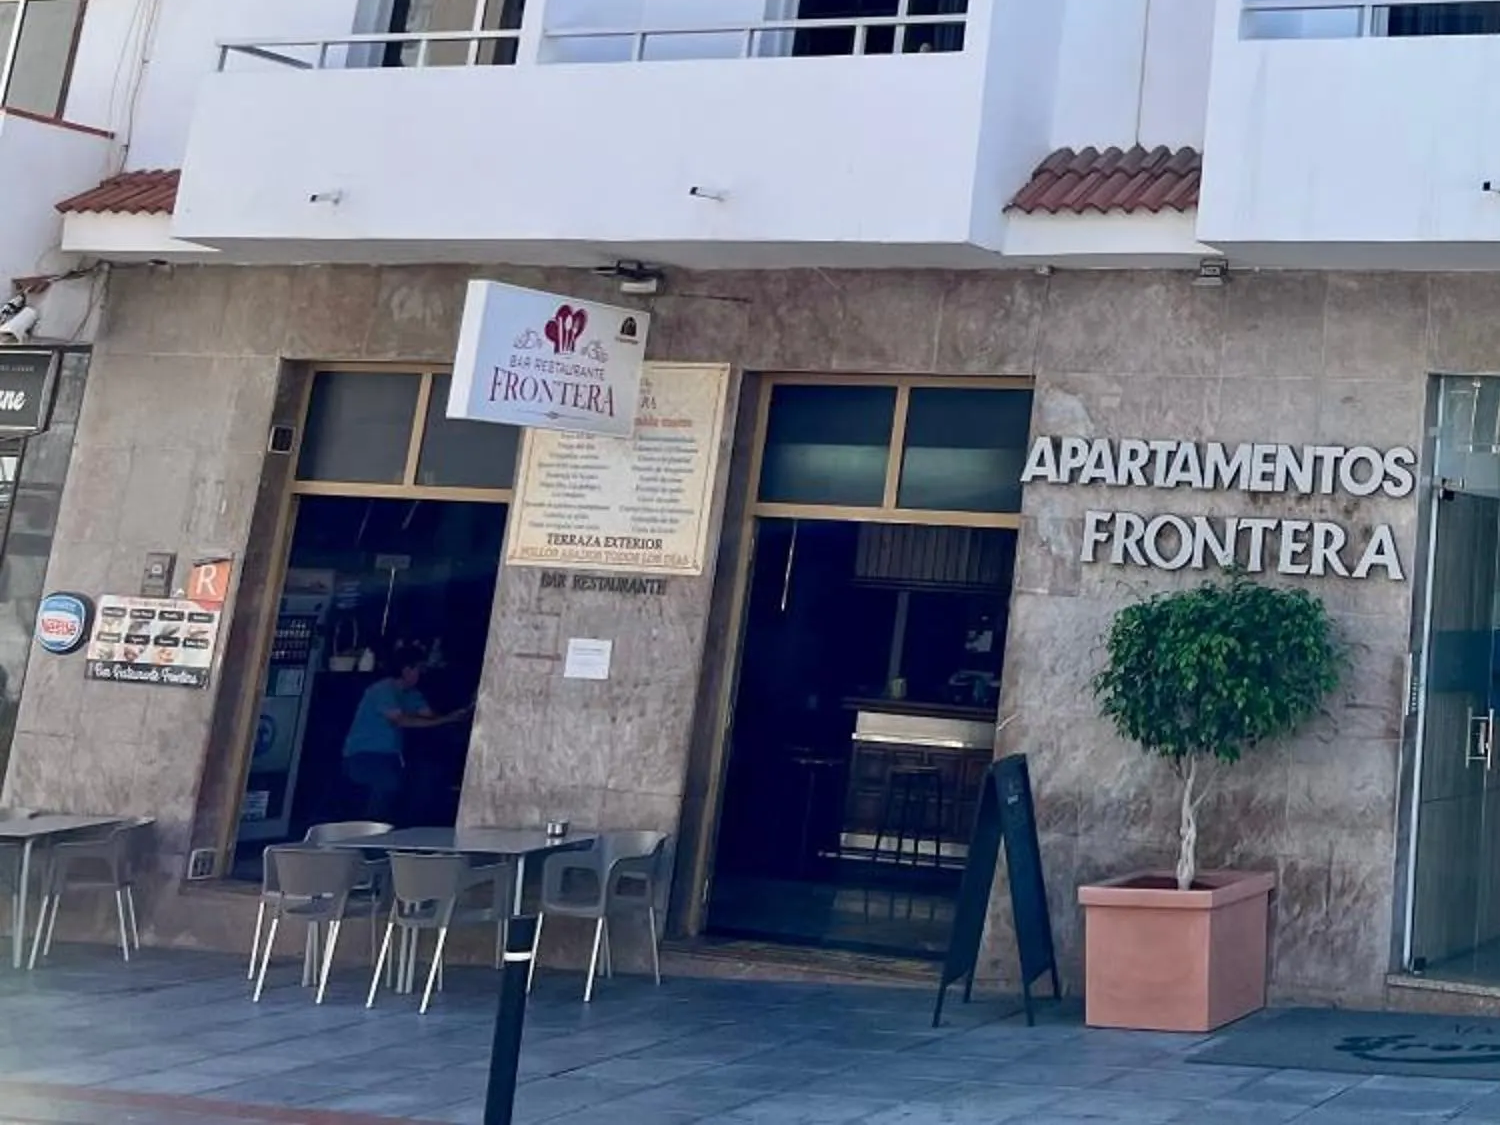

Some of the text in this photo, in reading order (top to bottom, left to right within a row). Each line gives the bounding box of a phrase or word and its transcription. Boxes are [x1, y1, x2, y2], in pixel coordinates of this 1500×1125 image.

[509, 354, 606, 381] BAR RESTAURANTE
[488, 366, 616, 418] FRONTERA
[1020, 435, 1418, 498] APARTAMENTOS
[547, 533, 663, 551] TERRAZA EXTERIOR
[1080, 509, 1406, 581] FRONTERA
[194, 563, 217, 596] R
[540, 571, 668, 596] BAR RESTAURANTE
